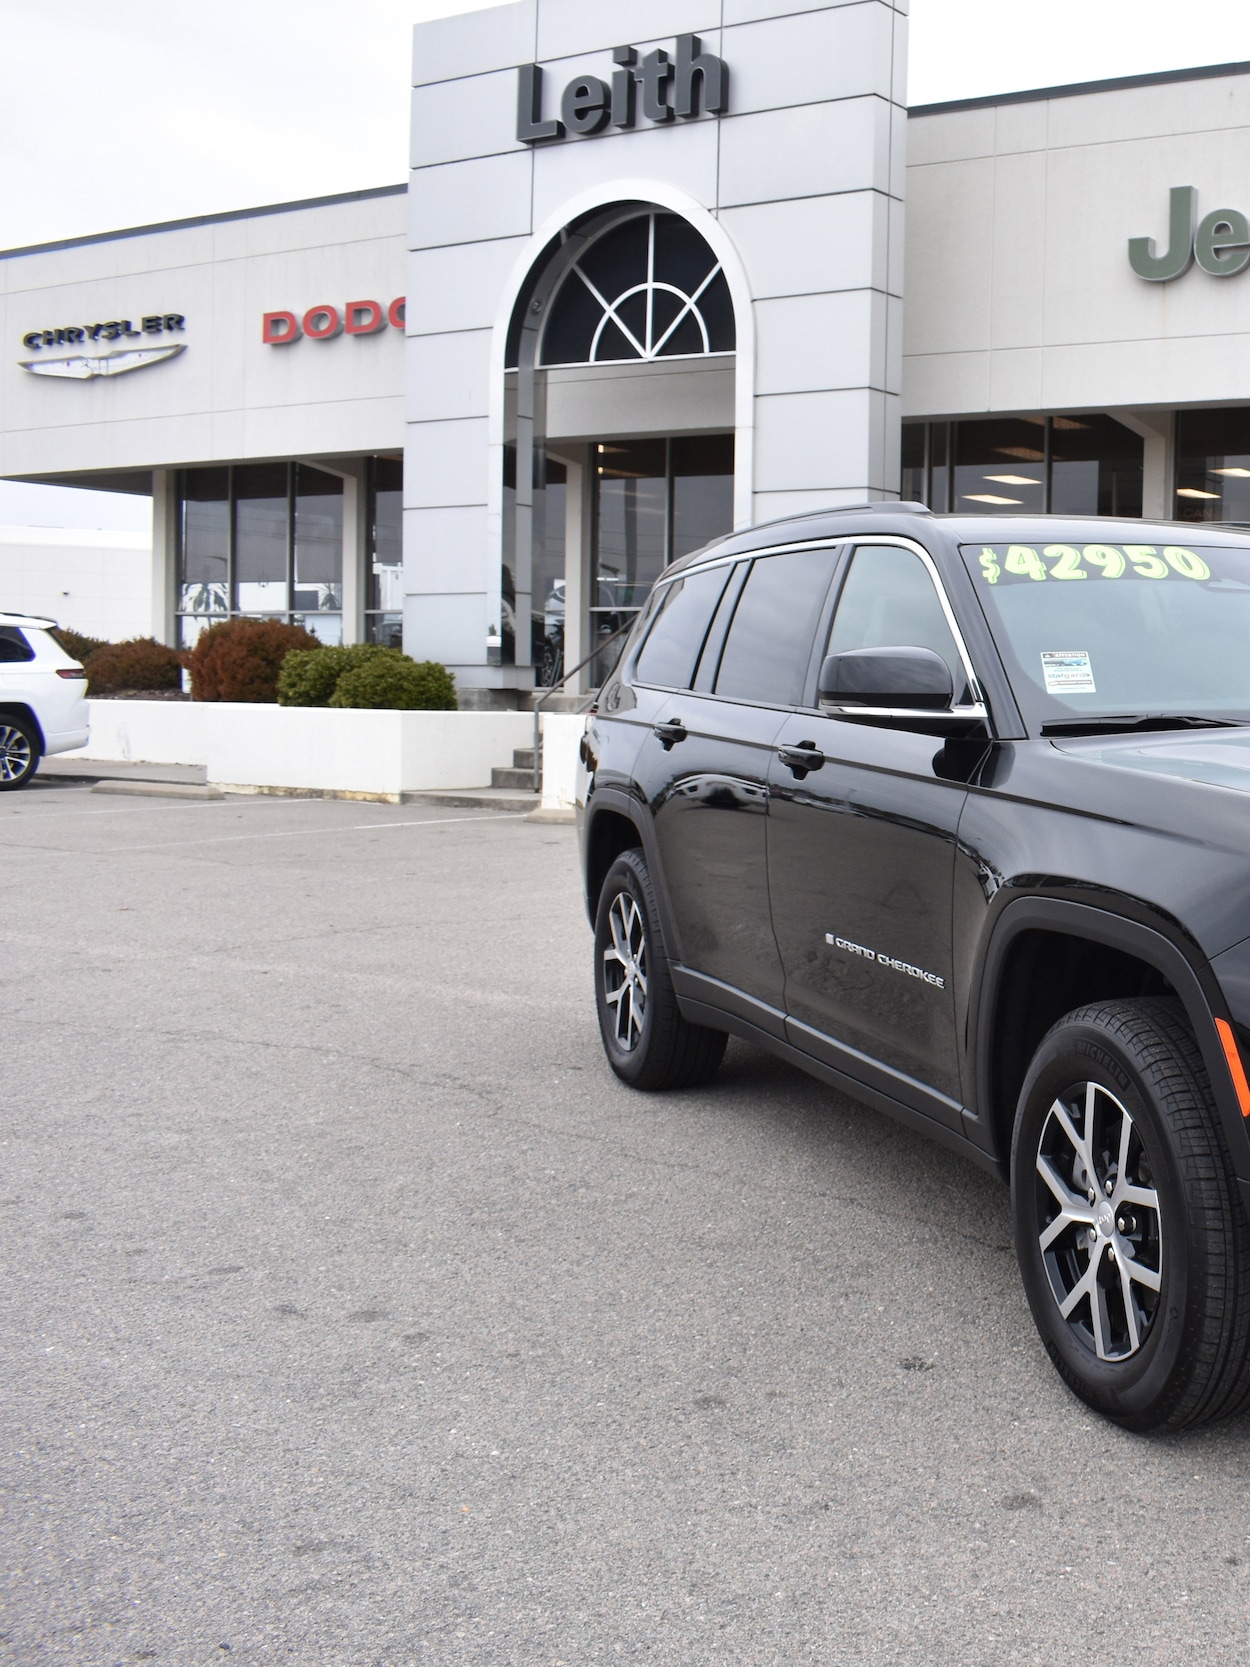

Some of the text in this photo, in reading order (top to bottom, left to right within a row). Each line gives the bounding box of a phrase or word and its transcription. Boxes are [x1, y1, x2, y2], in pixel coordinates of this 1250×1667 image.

[517, 34, 729, 143] Leith
[22, 313, 185, 349] CHRYSLER
[979, 544, 1210, 584] $42950
[835, 937, 945, 989] GRAND CHEROKEE
[1077, 1041, 1129, 1089] MICHELIN
